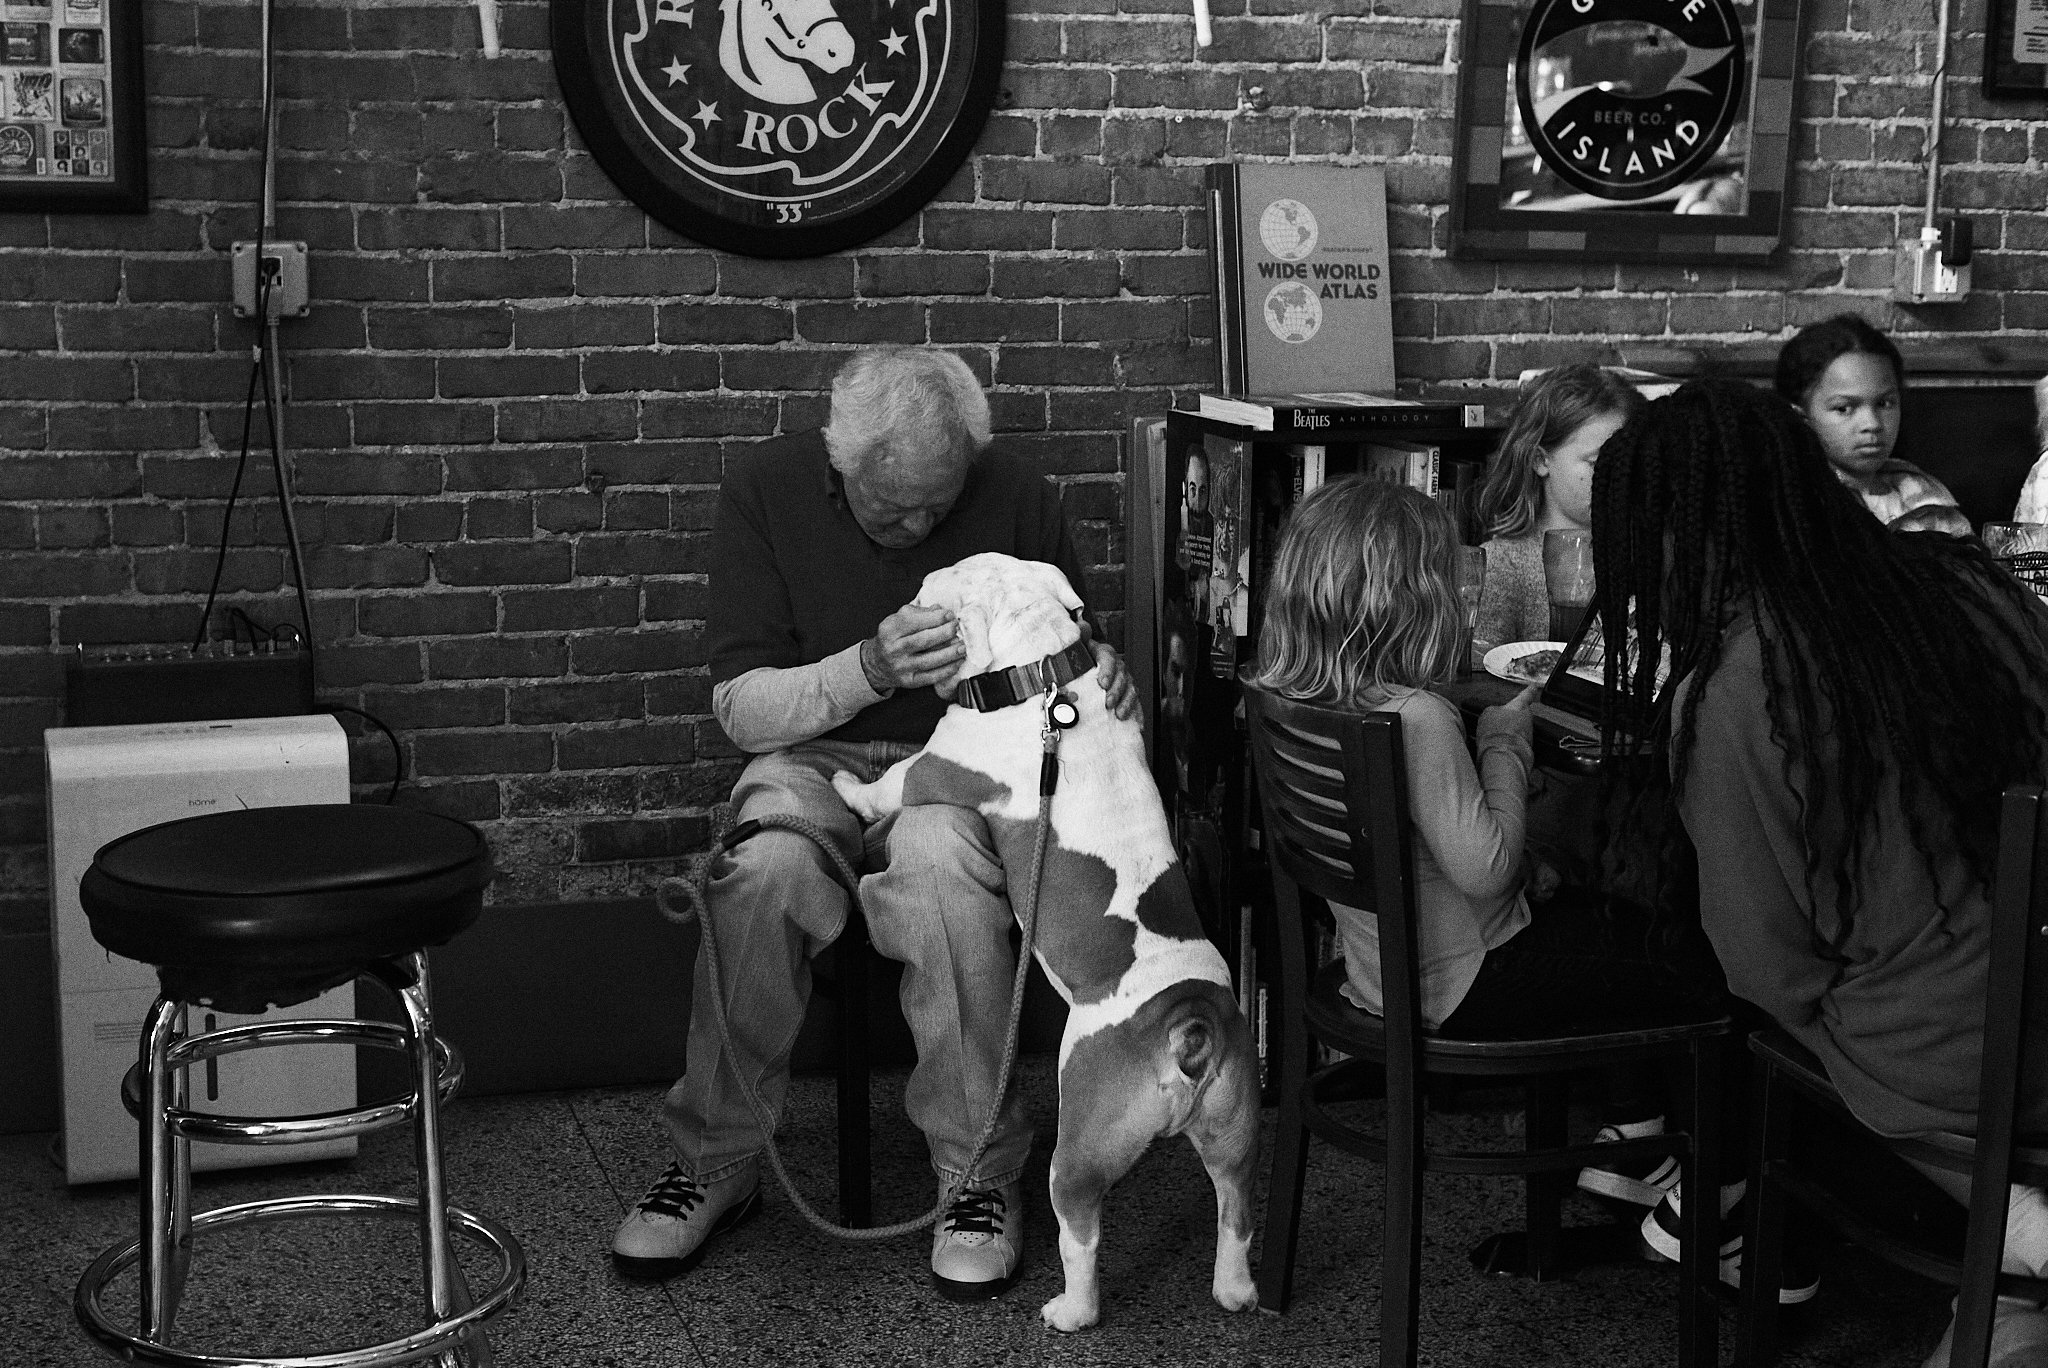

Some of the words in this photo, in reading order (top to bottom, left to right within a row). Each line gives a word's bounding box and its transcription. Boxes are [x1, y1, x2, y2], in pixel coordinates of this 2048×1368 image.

[737, 62, 895, 155] ROCK
[1594, 110, 1633, 125] BEER
[1557, 120, 1700, 176] ISLAND
[1257, 262, 1308, 279] WIDE
[1312, 263, 1381, 280] WORLD
[1320, 283, 1378, 300] ATLAS
[1339, 415, 1430, 423] ANTHOLOGY
